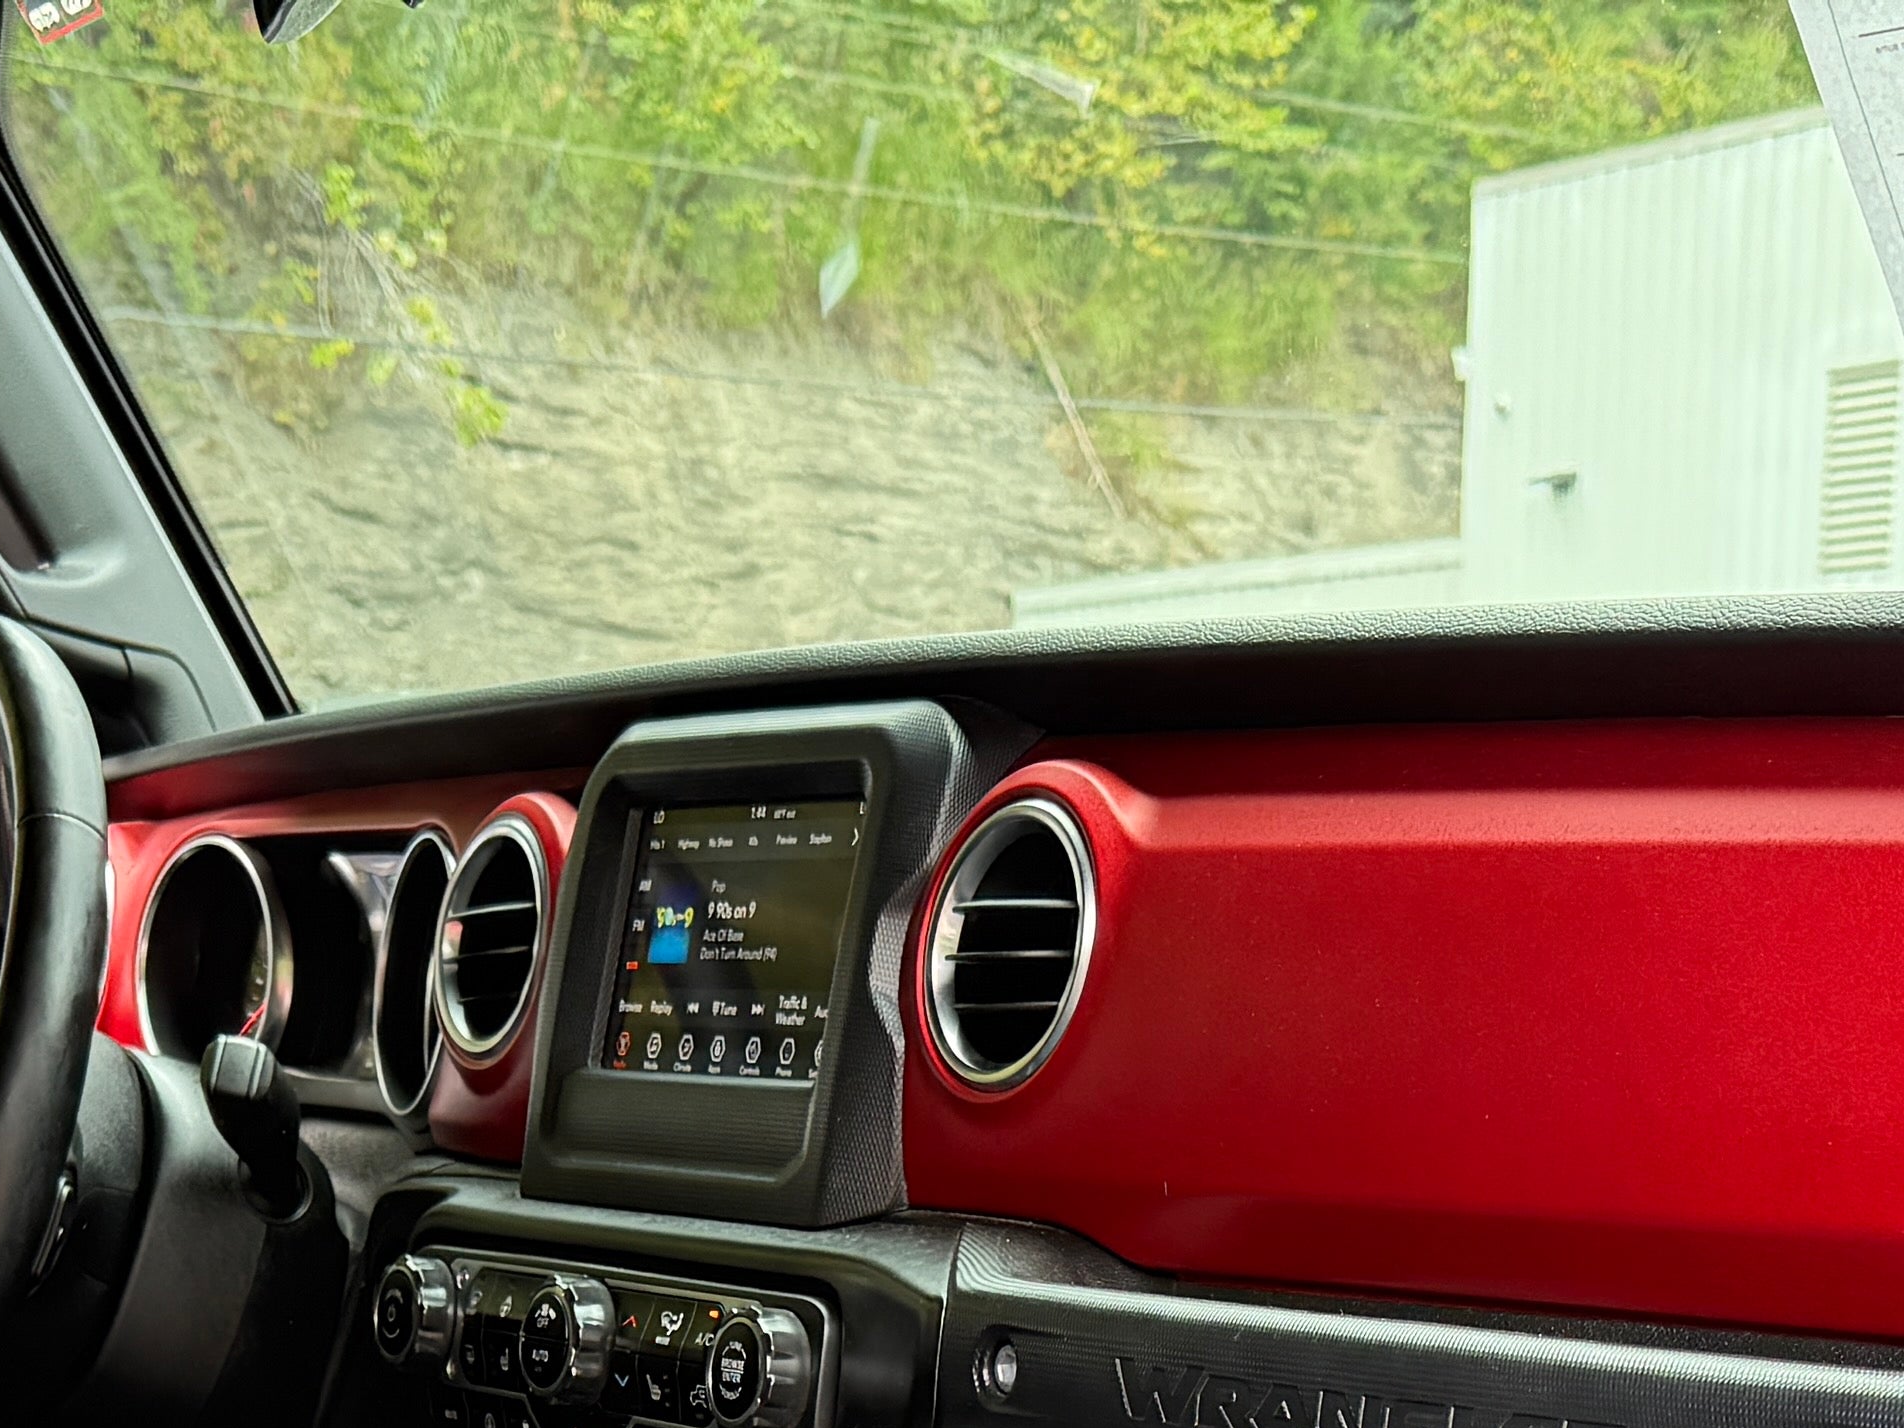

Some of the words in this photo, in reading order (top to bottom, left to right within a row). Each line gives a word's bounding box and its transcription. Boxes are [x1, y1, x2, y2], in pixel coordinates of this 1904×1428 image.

[711, 879, 726, 894] Pop
[707, 901, 715, 919] 9
[716, 901, 733, 920] 90s
[733, 906, 747, 919] on
[748, 901, 757, 919] 9
[632, 918, 646, 932] FM
[702, 930, 716, 943] Ace
[720, 947, 736, 961] Turn
[736, 946, 763, 961] Around
[650, 1000, 674, 1017] Replay
[719, 1002, 738, 1017] Tune
[779, 995, 801, 1010] Traffic
[775, 1012, 806, 1027] Weather
[695, 1332, 715, 1346] A/C
[721, 1358, 745, 1371] BROWSE
